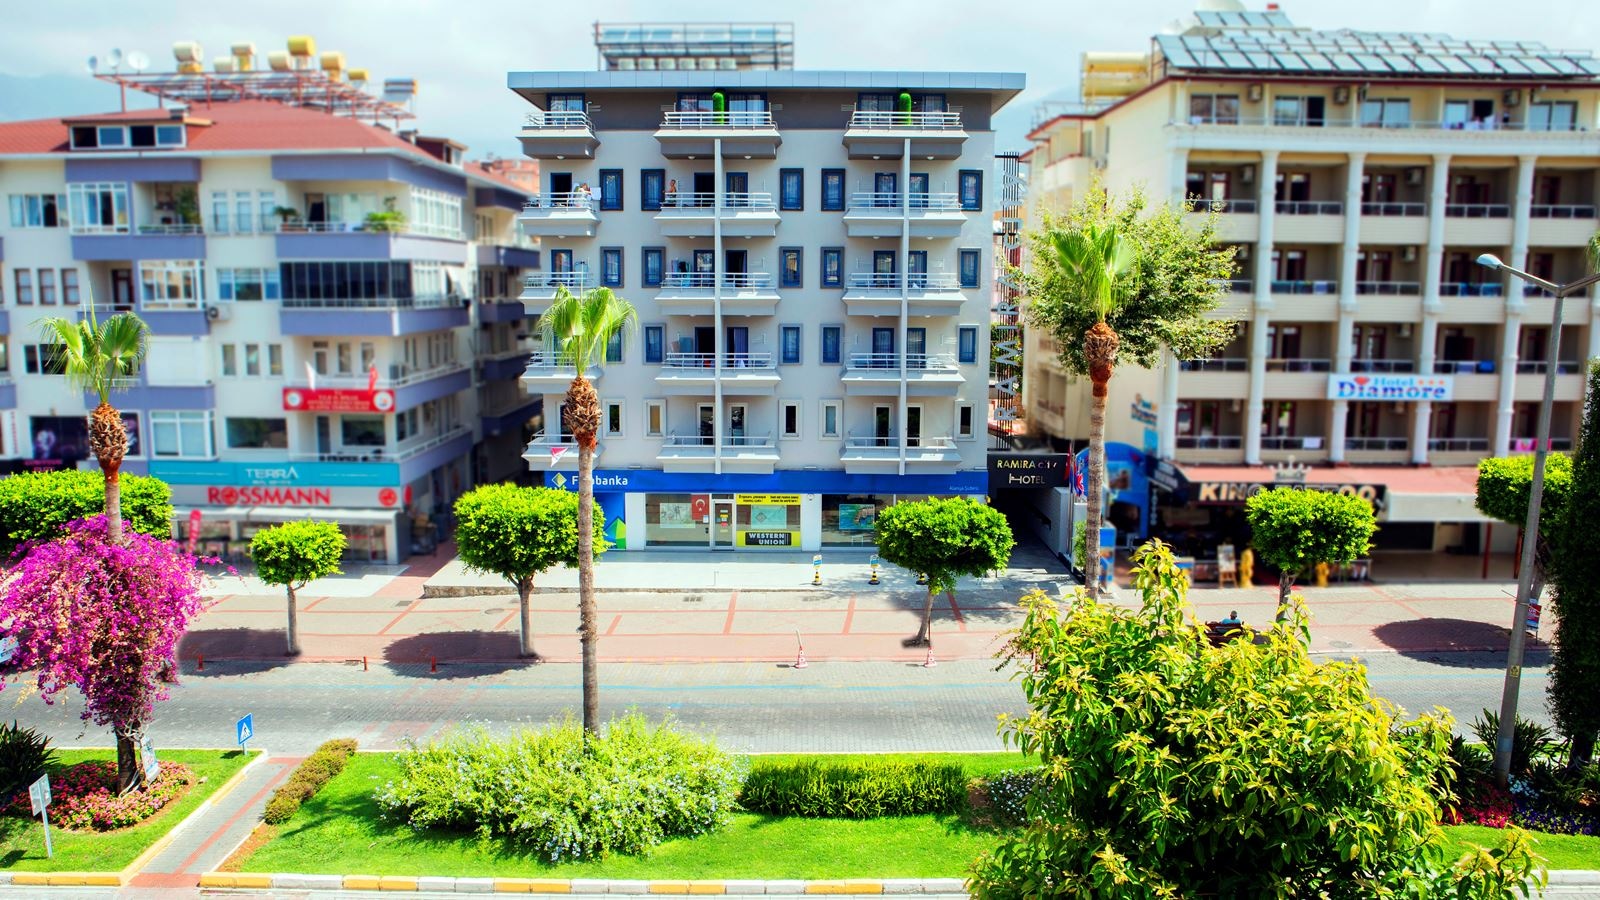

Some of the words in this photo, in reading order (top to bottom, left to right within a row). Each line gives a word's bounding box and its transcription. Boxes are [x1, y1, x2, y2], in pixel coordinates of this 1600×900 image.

[994, 273, 1019, 421] RAMIRA
[1374, 377, 1414, 386] Hotel
[1338, 381, 1446, 398] Diamore
[997, 459, 1036, 469] RAMIRA
[245, 466, 299, 479] TERRA
[571, 475, 629, 486] Fbanka
[207, 486, 331, 506] ROSSMANN
